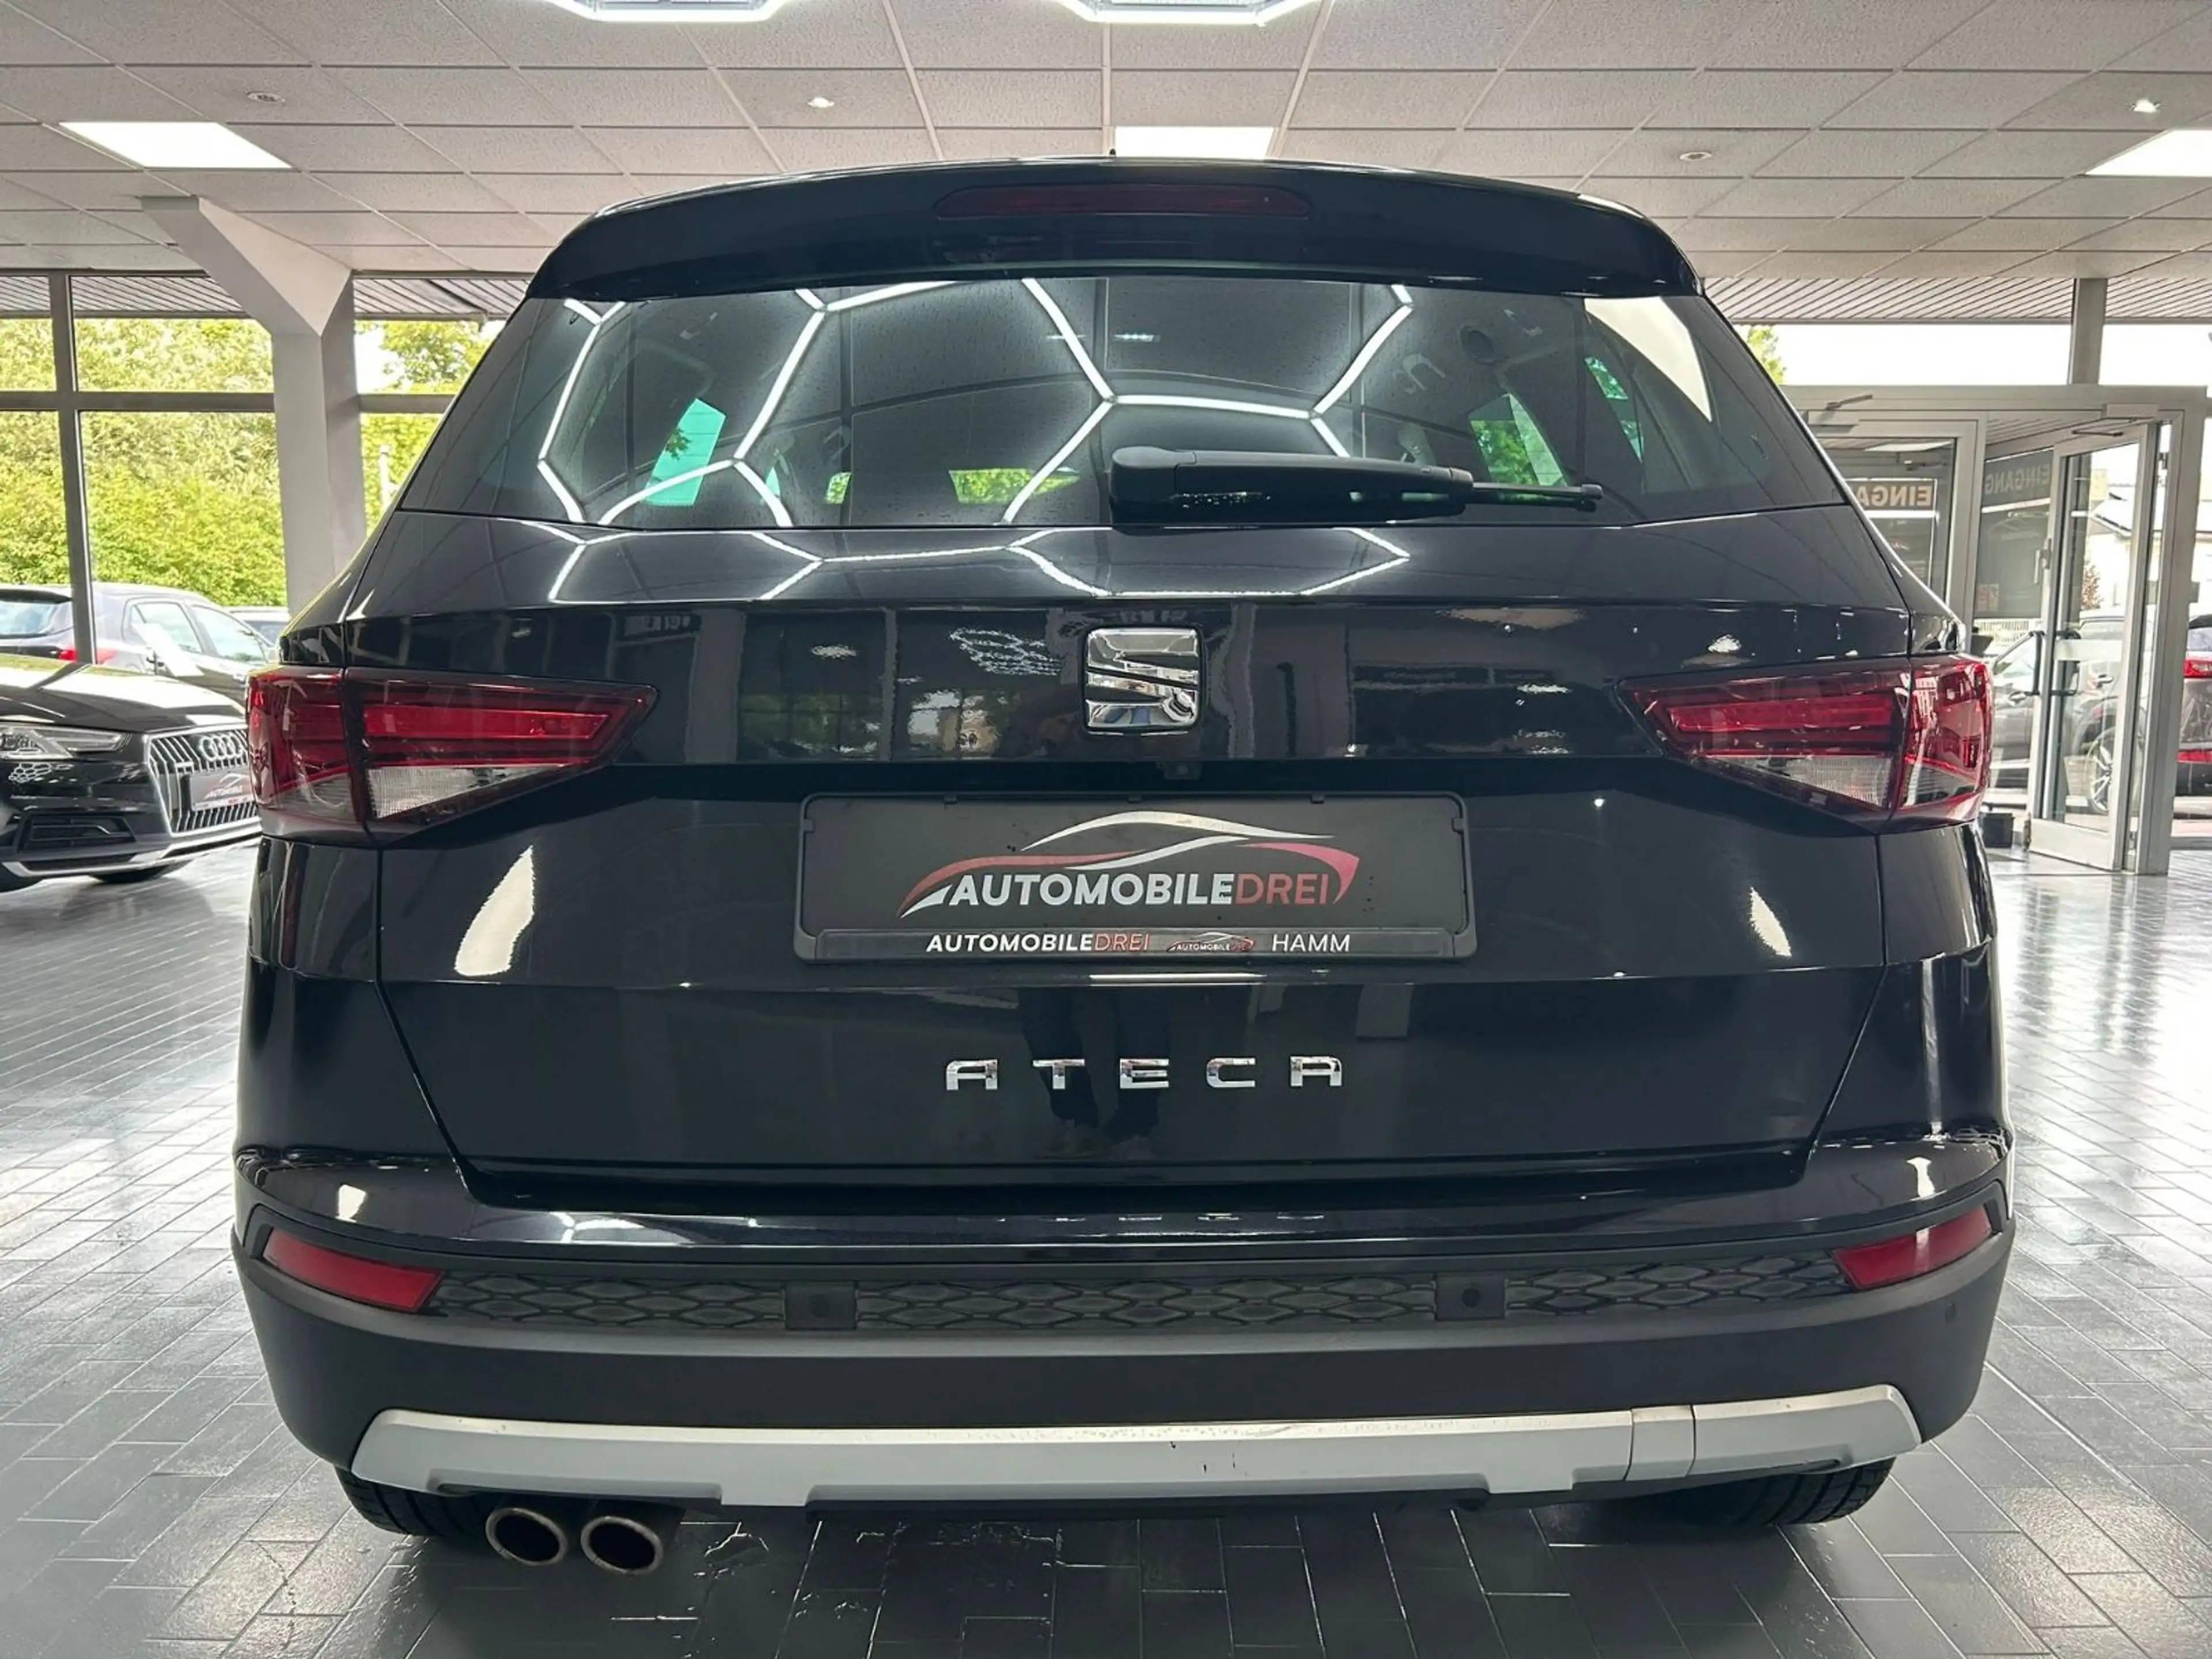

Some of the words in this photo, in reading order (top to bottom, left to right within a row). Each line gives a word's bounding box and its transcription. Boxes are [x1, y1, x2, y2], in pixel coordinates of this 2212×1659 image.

[949, 873, 1328, 906] AUTOMOBILEDREI
[926, 933, 1150, 952] AUTOMOBILEDREI
[1272, 933, 1350, 952] HAMM
[946, 1056, 1342, 1090] ATECA
